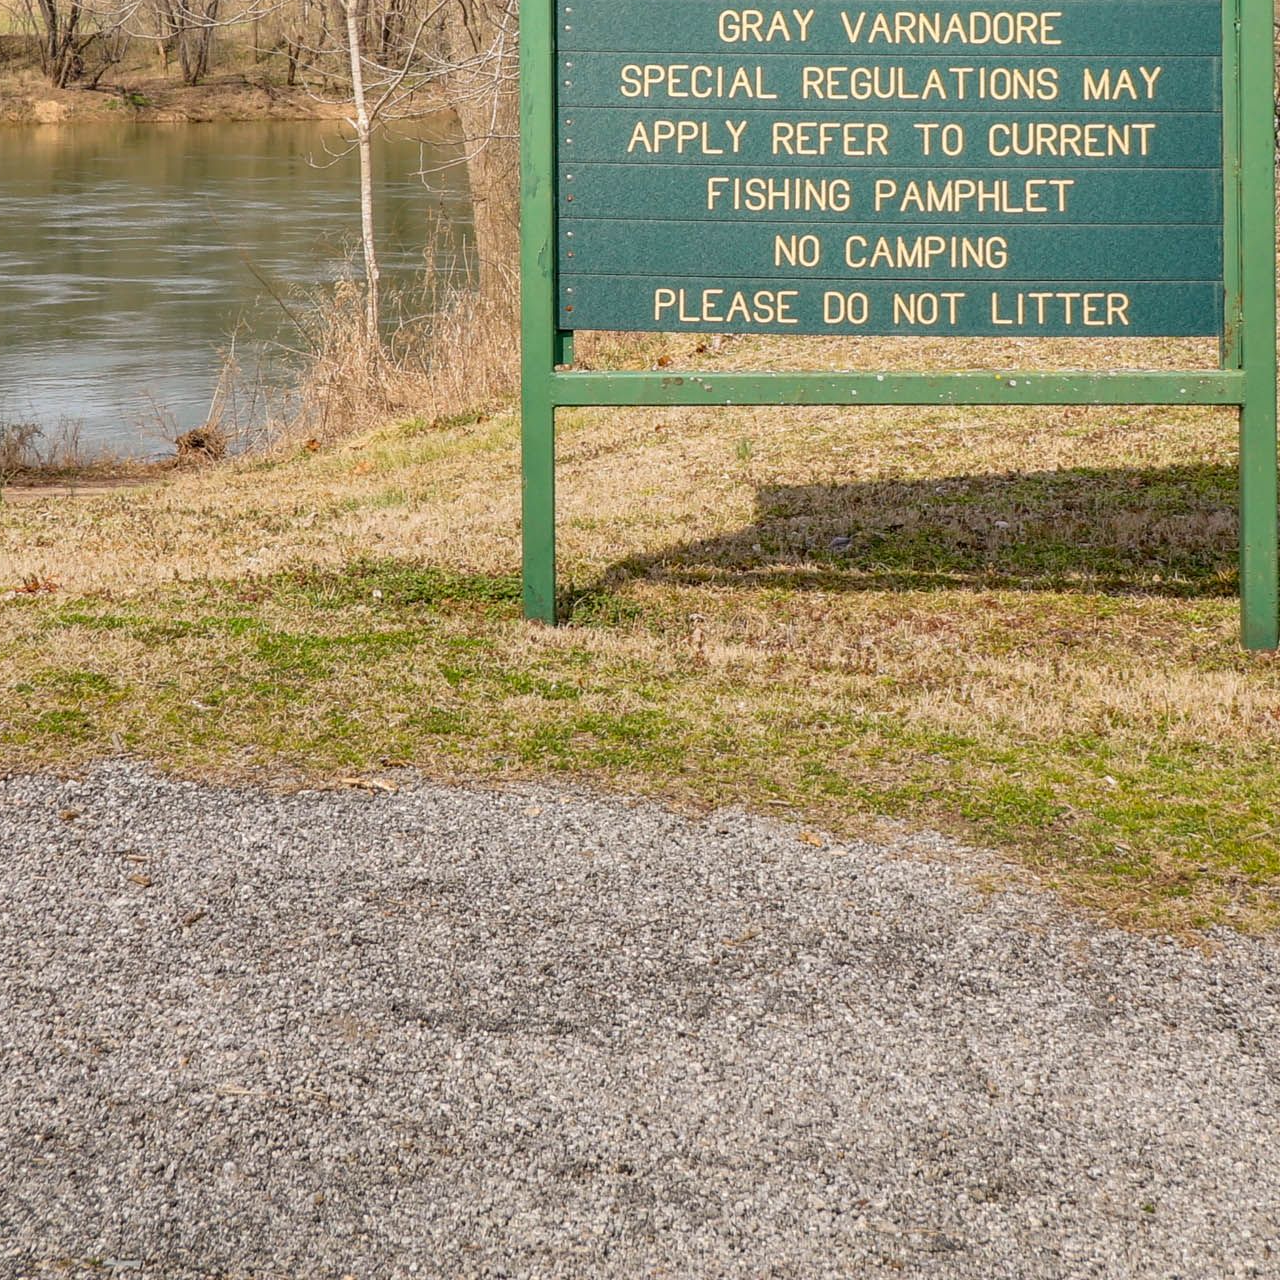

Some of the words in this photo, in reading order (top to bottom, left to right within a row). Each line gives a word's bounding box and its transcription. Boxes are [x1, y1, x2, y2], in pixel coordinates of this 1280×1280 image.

[718, 9, 815, 43] GRAY
[840, 10, 1062, 46] VARNADORE
[620, 65, 777, 99] SPECIAL
[802, 66, 1059, 101] REGULATIONS
[1082, 66, 1162, 100] MAY
[626, 121, 748, 155] APPLY
[772, 122, 889, 156] REFER
[914, 123, 963, 157] TO
[989, 123, 1155, 158] CURRENT
[707, 176, 850, 212] FISHING
[875, 179, 1074, 213] PAMPHLET
[774, 235, 820, 267] NO
[844, 235, 1008, 269] CAMPING
[655, 289, 798, 324] PLEASE
[824, 290, 868, 324] DO
[893, 291, 965, 325] NOT
[992, 292, 1129, 327] LITTER
